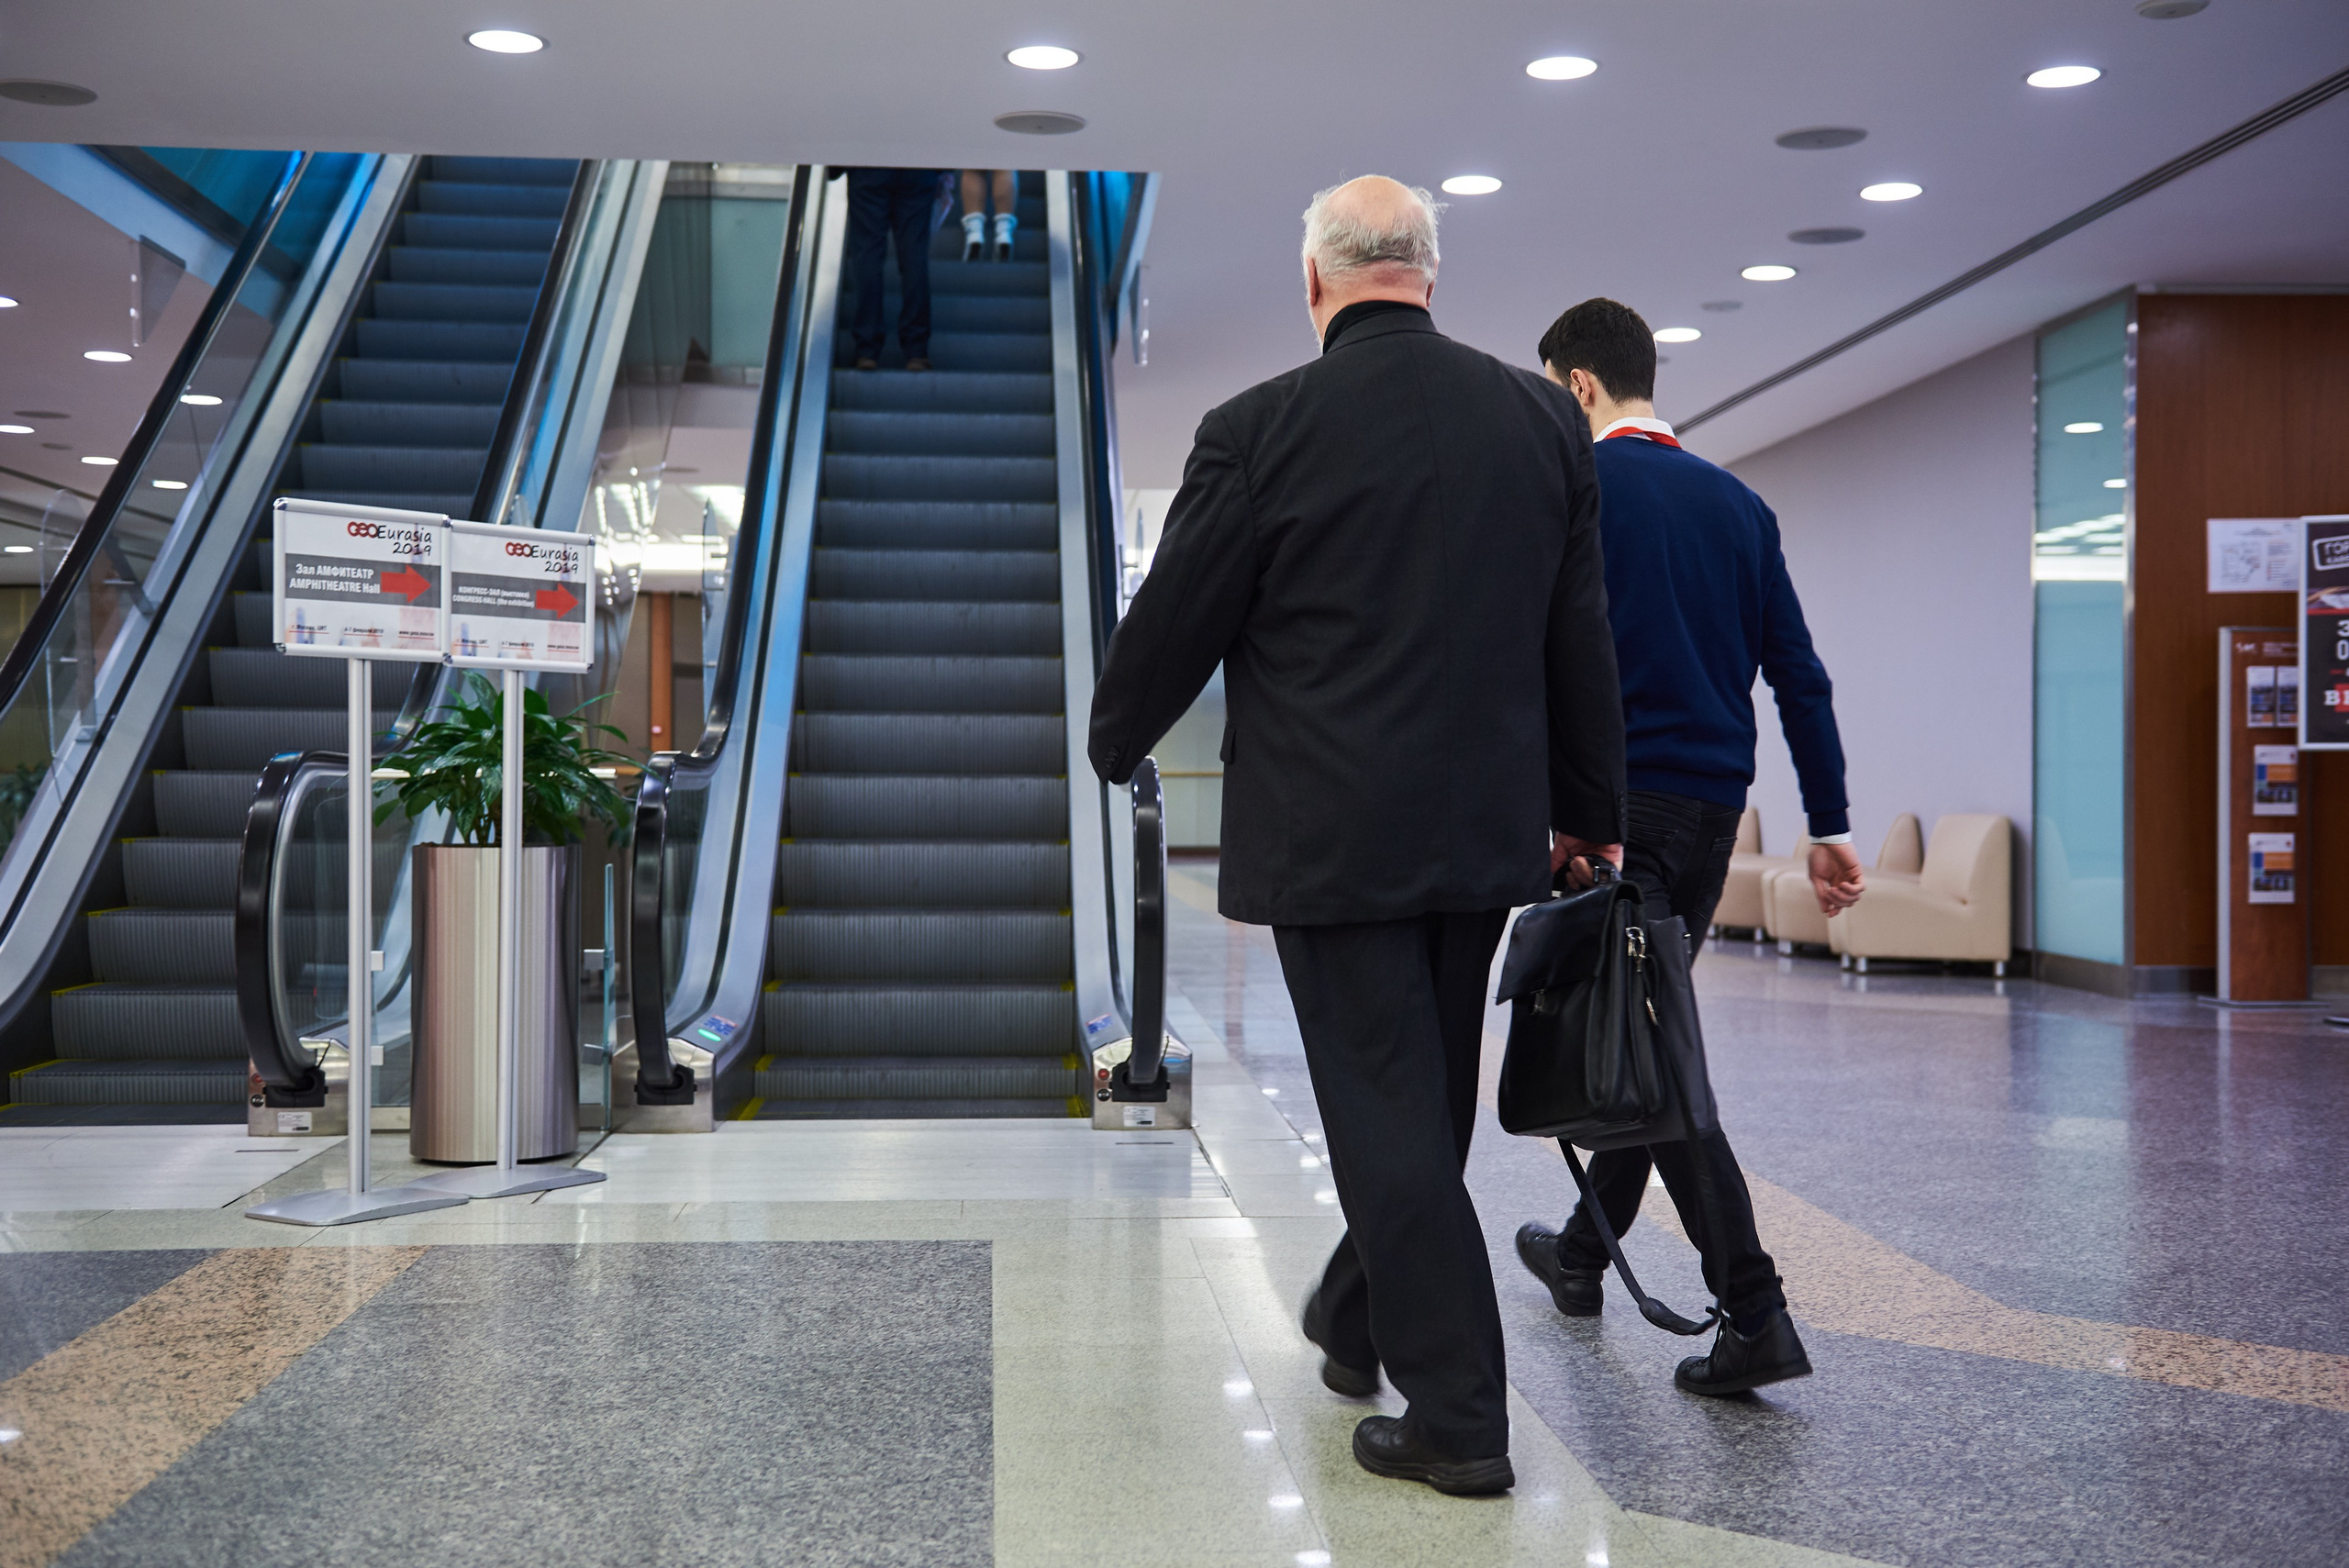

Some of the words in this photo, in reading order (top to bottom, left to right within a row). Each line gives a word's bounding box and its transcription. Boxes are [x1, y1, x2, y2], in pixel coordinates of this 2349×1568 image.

[393, 542, 432, 556] 2019
[295, 563, 316, 575] Зал
[316, 564, 374, 579] АМФИТЕАТР
[544, 561, 579, 573] 2019
[289, 578, 361, 593] AMPHITHEATRE
[362, 584, 381, 595] Hall
